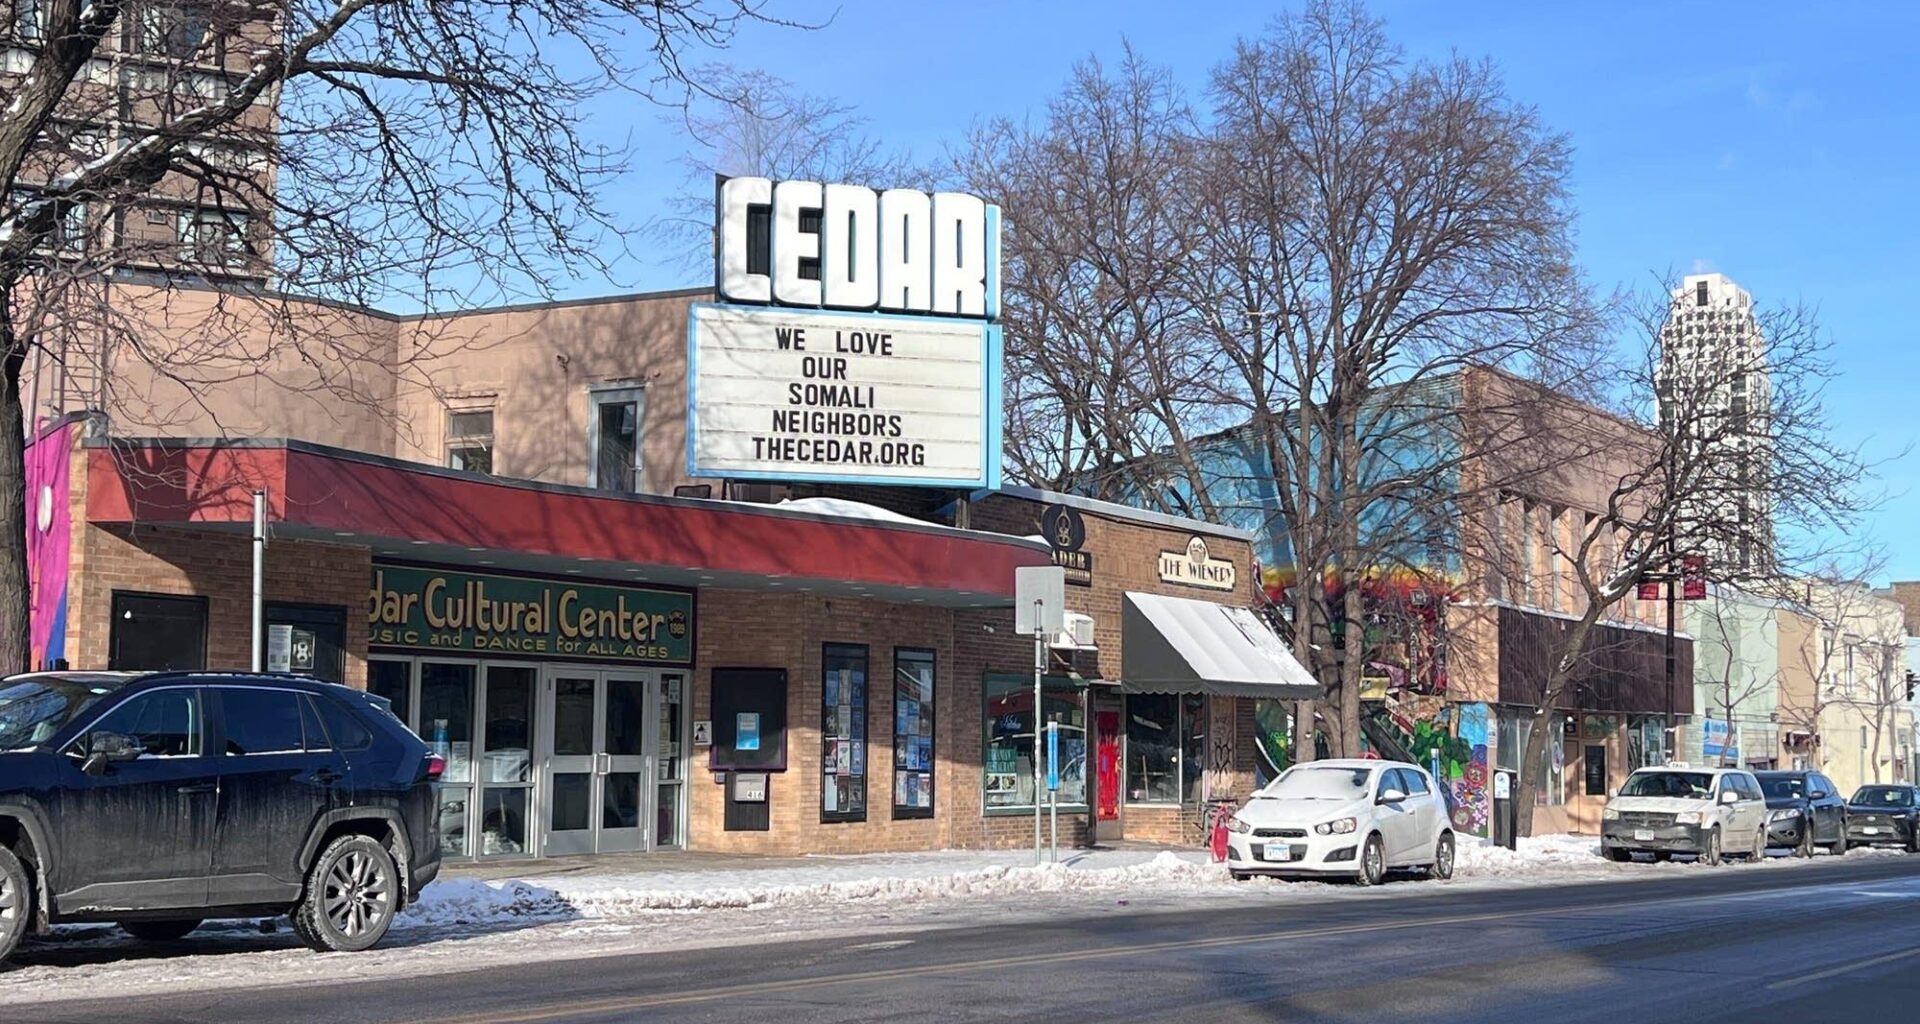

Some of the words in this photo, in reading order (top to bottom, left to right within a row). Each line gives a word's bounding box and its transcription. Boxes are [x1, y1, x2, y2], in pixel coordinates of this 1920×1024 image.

[720, 177, 986, 315] CEDAR
[775, 327, 805, 351] WE
[836, 331, 893, 356] LOVE
[802, 356, 847, 380] OUR
[789, 383, 874, 409] SOMALI
[772, 410, 901, 437] NEIGHBORS
[752, 437, 925, 466] THECEDAR.ORG
[1162, 558, 1182, 577] THE
[1188, 562, 1232, 583] WIENERY
[424, 577, 550, 634] Cultural
[558, 589, 665, 641] Center
[430, 627, 463, 646] and
[474, 635, 546, 651] DANCE
[556, 635, 581, 653] for
[586, 642, 617, 655] ALL
[623, 644, 668, 658] AGES
